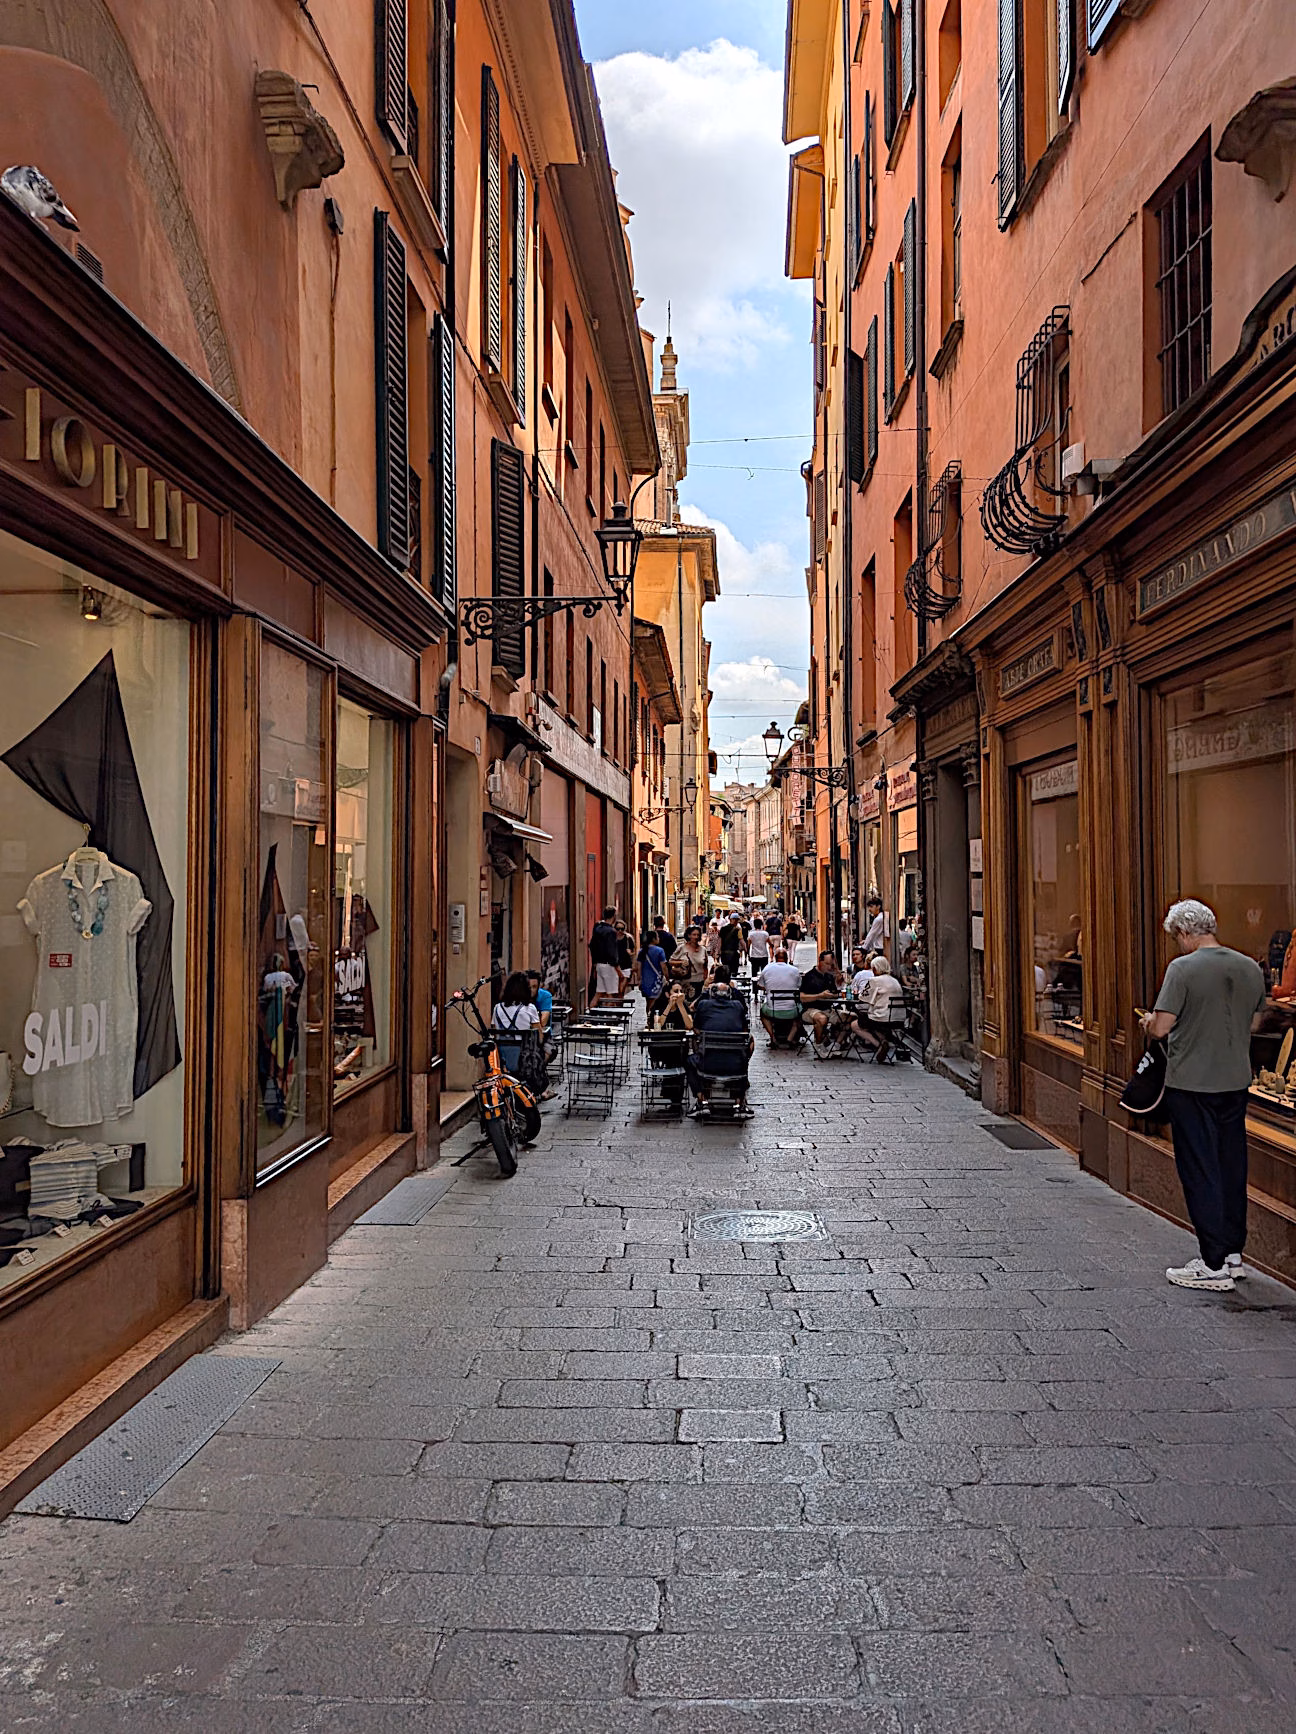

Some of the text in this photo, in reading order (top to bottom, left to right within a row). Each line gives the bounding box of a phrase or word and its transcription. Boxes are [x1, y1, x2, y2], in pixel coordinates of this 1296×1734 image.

[0, 359, 199, 560] IORINI
[1144, 511, 1266, 606] FERDINANDO
[338, 955, 366, 995] SALDI
[22, 1000, 107, 1076] SALDI
